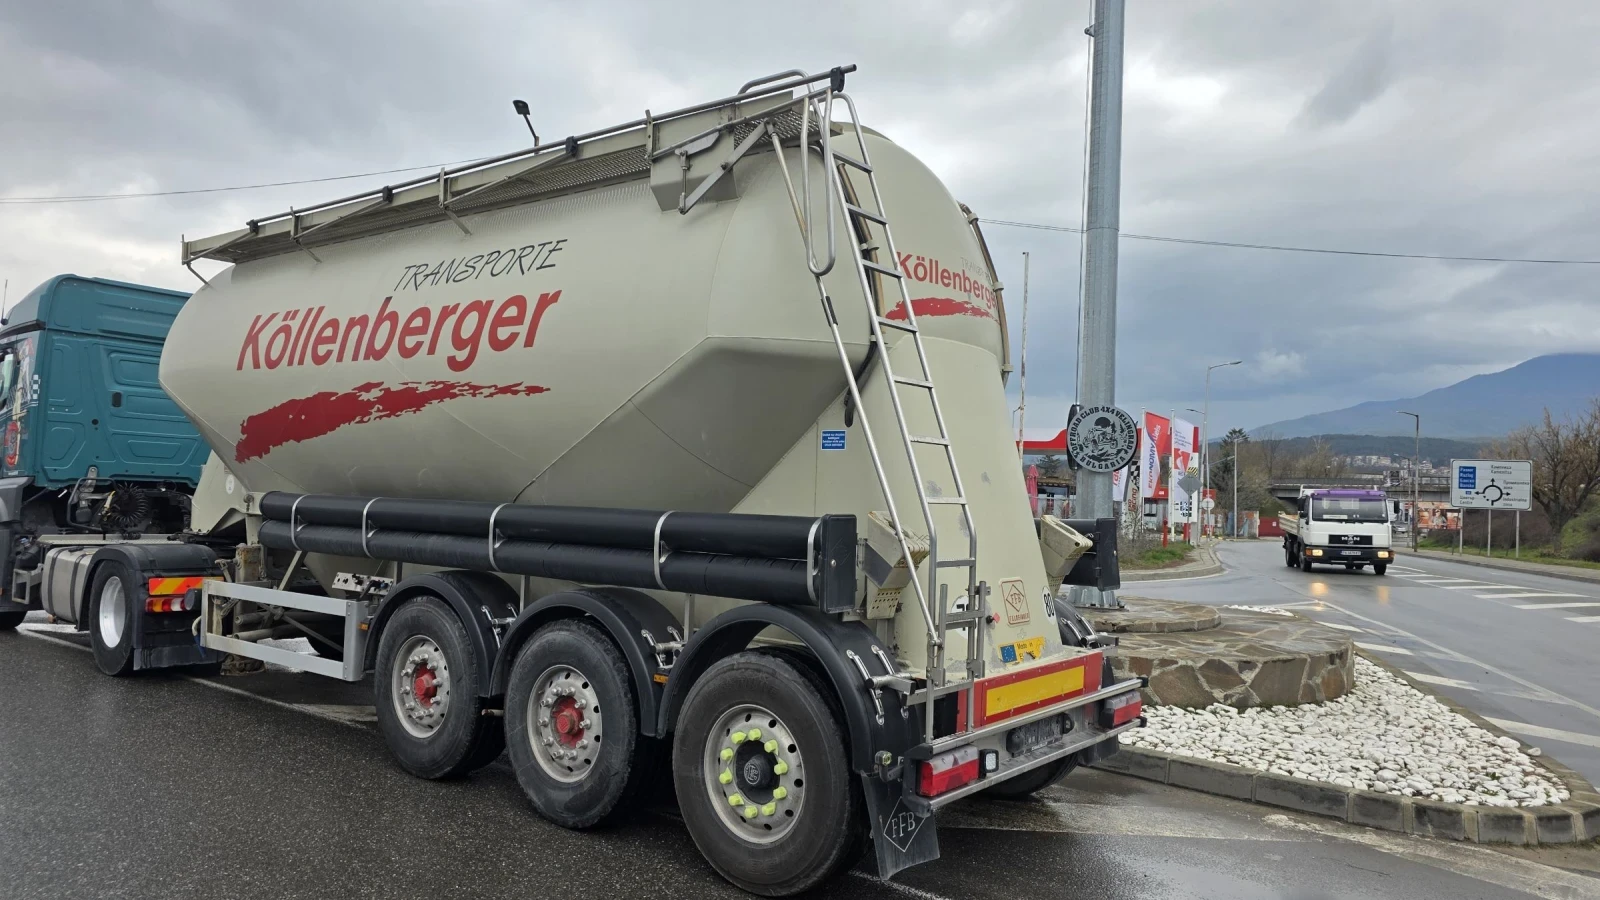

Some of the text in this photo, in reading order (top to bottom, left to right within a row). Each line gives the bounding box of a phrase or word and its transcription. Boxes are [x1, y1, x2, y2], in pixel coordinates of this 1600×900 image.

[394, 239, 567, 291] TRANSPORTE
[237, 290, 562, 372] Köllenberger
[1070, 406, 1134, 453] OFFROAD CLUB 4X4 VELINGRAD
[1080, 456, 1126, 469] BULGARIA
[1011, 592, 1022, 604] FFB
[1044, 592, 1055, 617] 80
[891, 811, 916, 838] FFB
